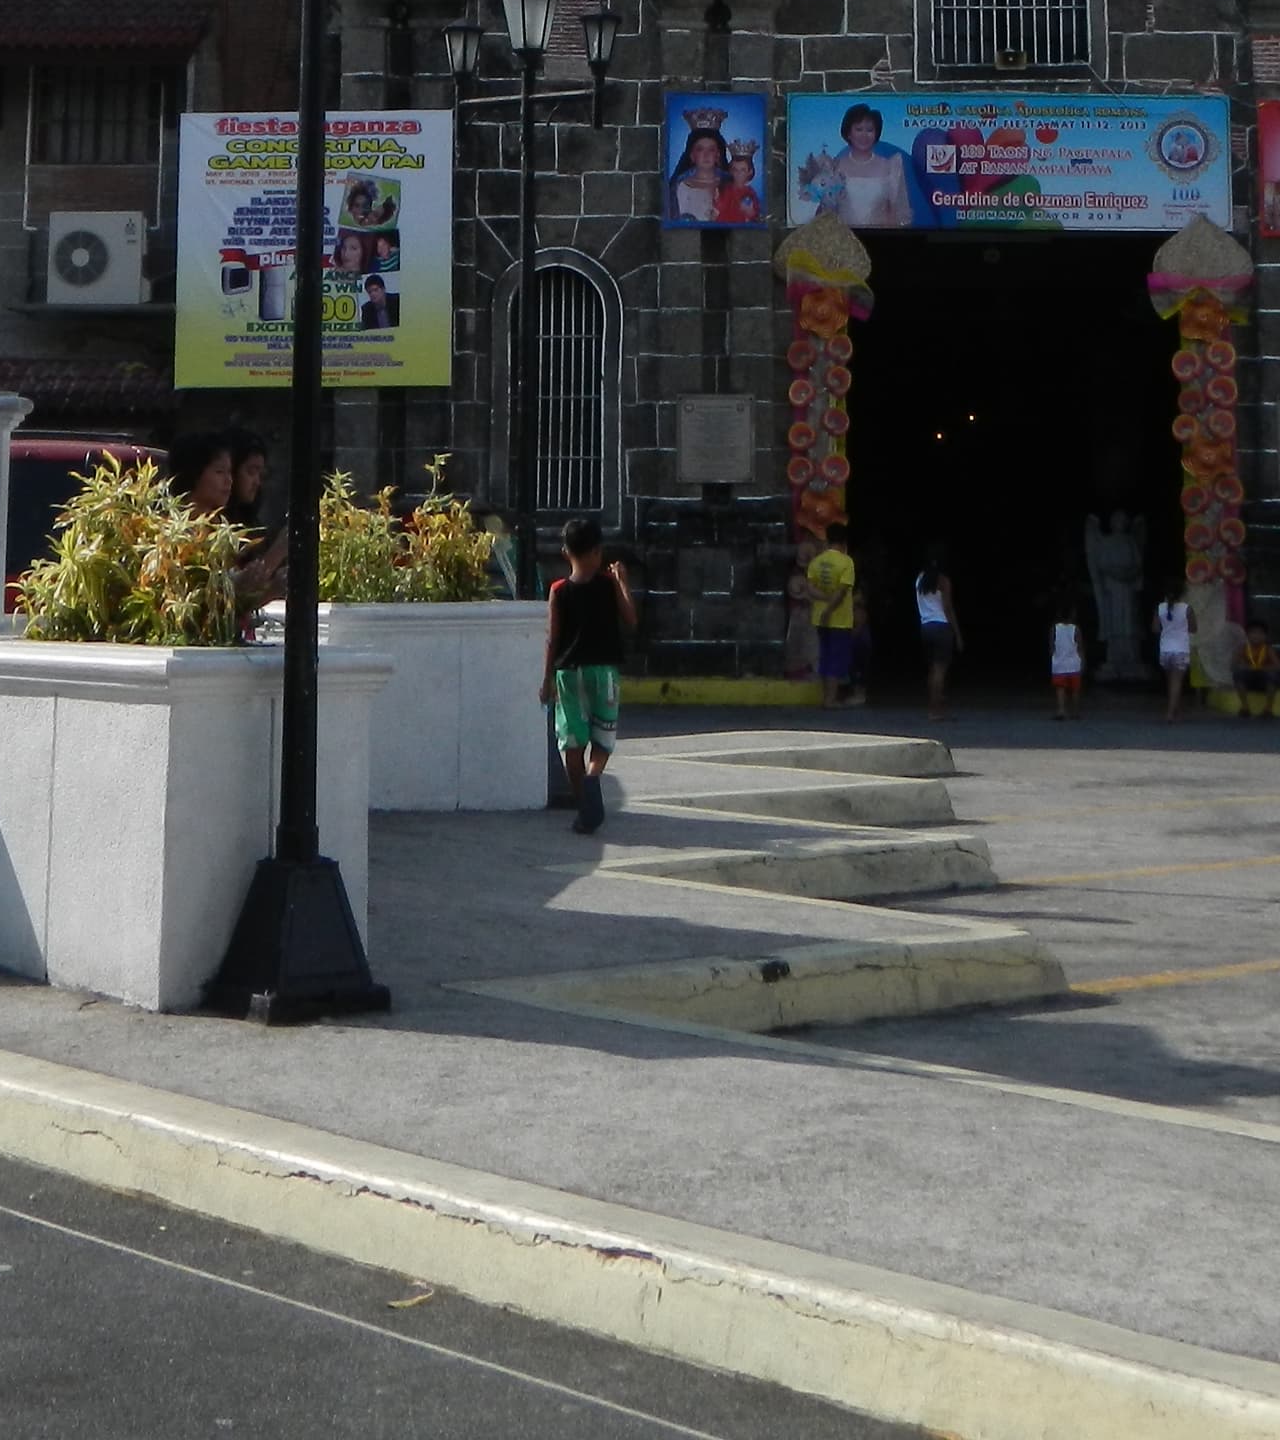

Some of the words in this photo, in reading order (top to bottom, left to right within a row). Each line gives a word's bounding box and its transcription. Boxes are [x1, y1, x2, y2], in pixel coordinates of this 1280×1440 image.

[215, 117, 421, 136] fiestaganza
[903, 119, 956, 129] BACOOR
[961, 119, 997, 129] TOWN
[1119, 120, 1147, 129] 2013
[226, 138, 356, 153] CONCRT
[959, 145, 985, 158] 100
[987, 145, 1029, 159] TAON
[208, 155, 292, 169] GAME
[958, 162, 978, 174] AT
[932, 191, 999, 206] Geraldine
[1003, 192, 1020, 207] de
[1023, 192, 1082, 208] Guzman
[1084, 192, 1149, 211] Enriquez
[1032, 210, 1079, 221] MAYOR
[1088, 211, 1123, 221] 2013
[259, 251, 296, 267] plus
